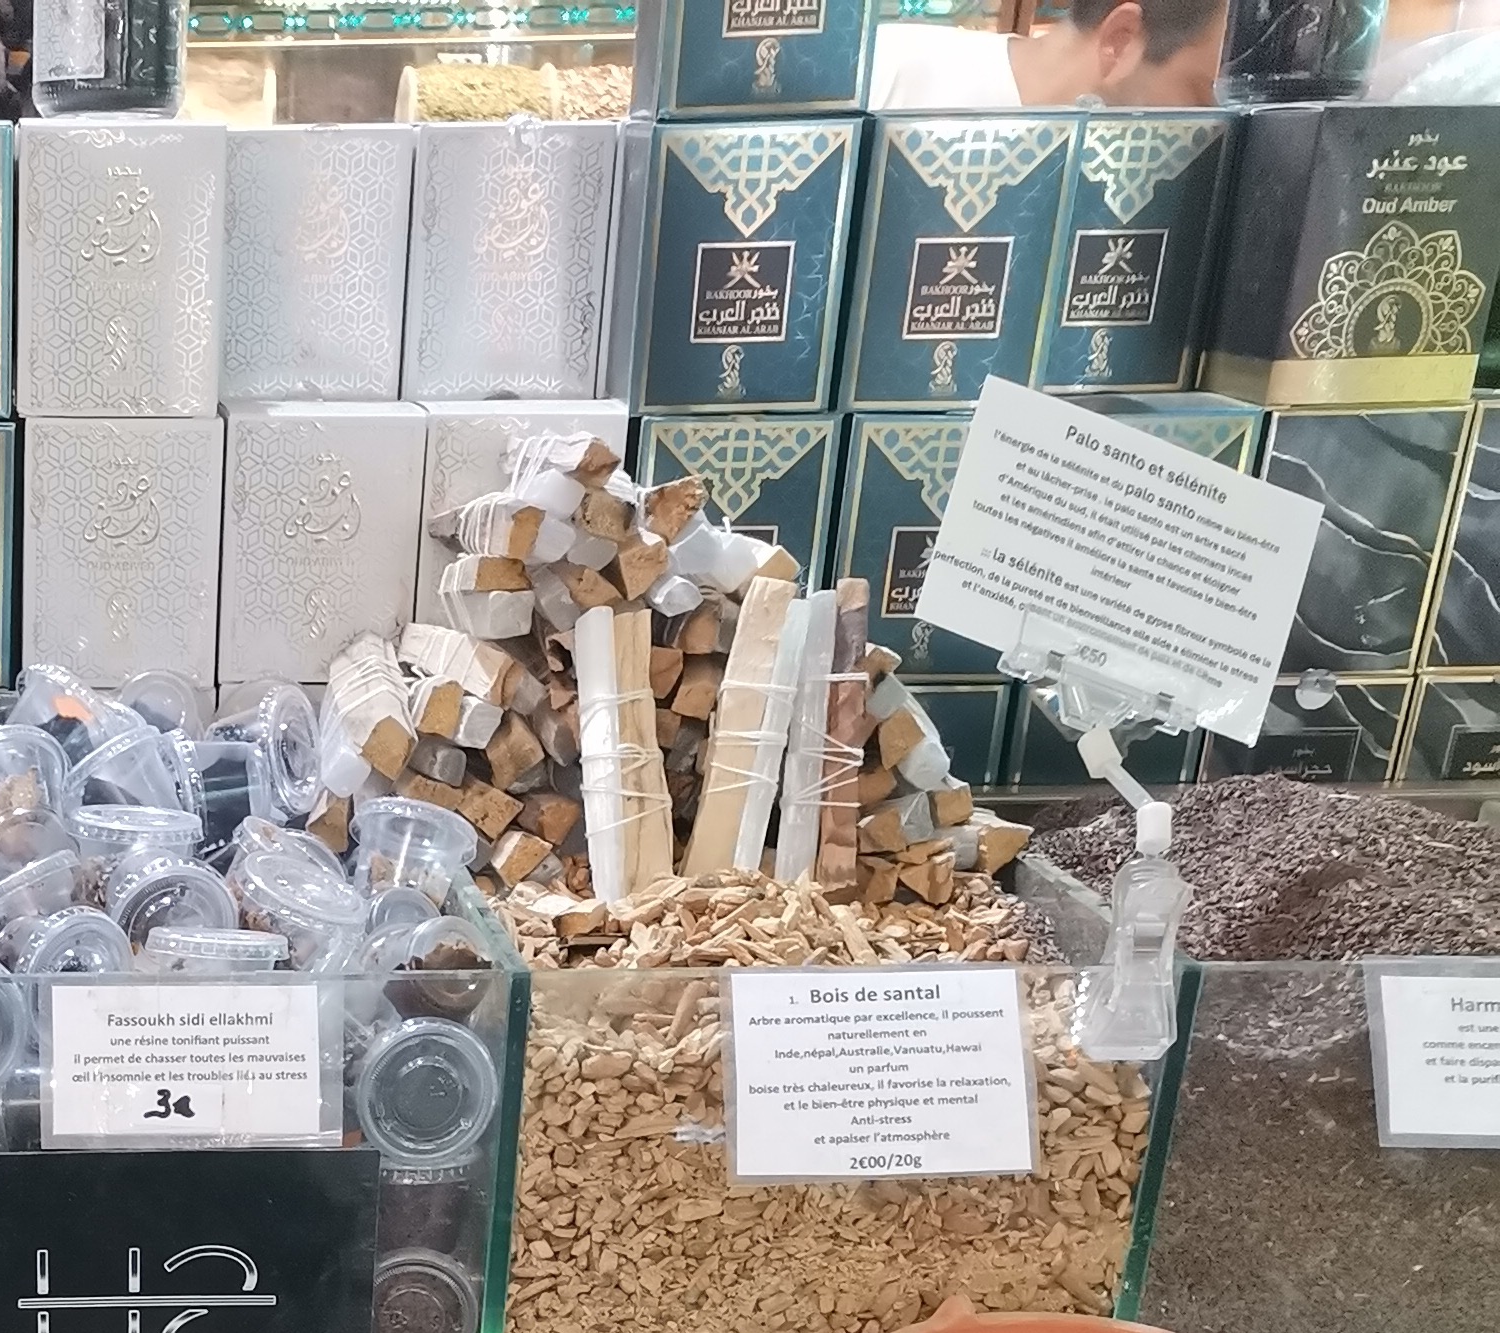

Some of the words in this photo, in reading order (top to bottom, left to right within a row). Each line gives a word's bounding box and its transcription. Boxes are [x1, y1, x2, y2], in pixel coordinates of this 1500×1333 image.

[1362, 196, 1399, 214] Oud
[1399, 196, 1459, 214] Amber
[1065, 424, 1100, 452] Palo
[1102, 444, 1146, 471] santo
[1148, 463, 1165, 479] et
[1166, 470, 1228, 505] sélénite
[992, 547, 1007, 564] la
[1007, 556, 1063, 587] sélénite
[809, 987, 849, 1004] Bois
[854, 986, 878, 1003] de
[883, 984, 940, 1002] santal
[107, 1012, 176, 1027] Fassoukh
[179, 1012, 205, 1027] sidi
[209, 1012, 273, 1026] ellakhmi
[110, 1038, 132, 1046] une
[134, 1035, 169, 1046] résine
[171, 1034, 220, 1046] tonifiant
[222, 1034, 270, 1048] puissant
[850, 1115, 913, 1126] Anti-stress
[813, 1135, 826, 1145] et
[828, 1133, 871, 1146] apaiser
[873, 1129, 951, 1143] l’atmosphère
[849, 1153, 923, 1170] 2€00/20g
